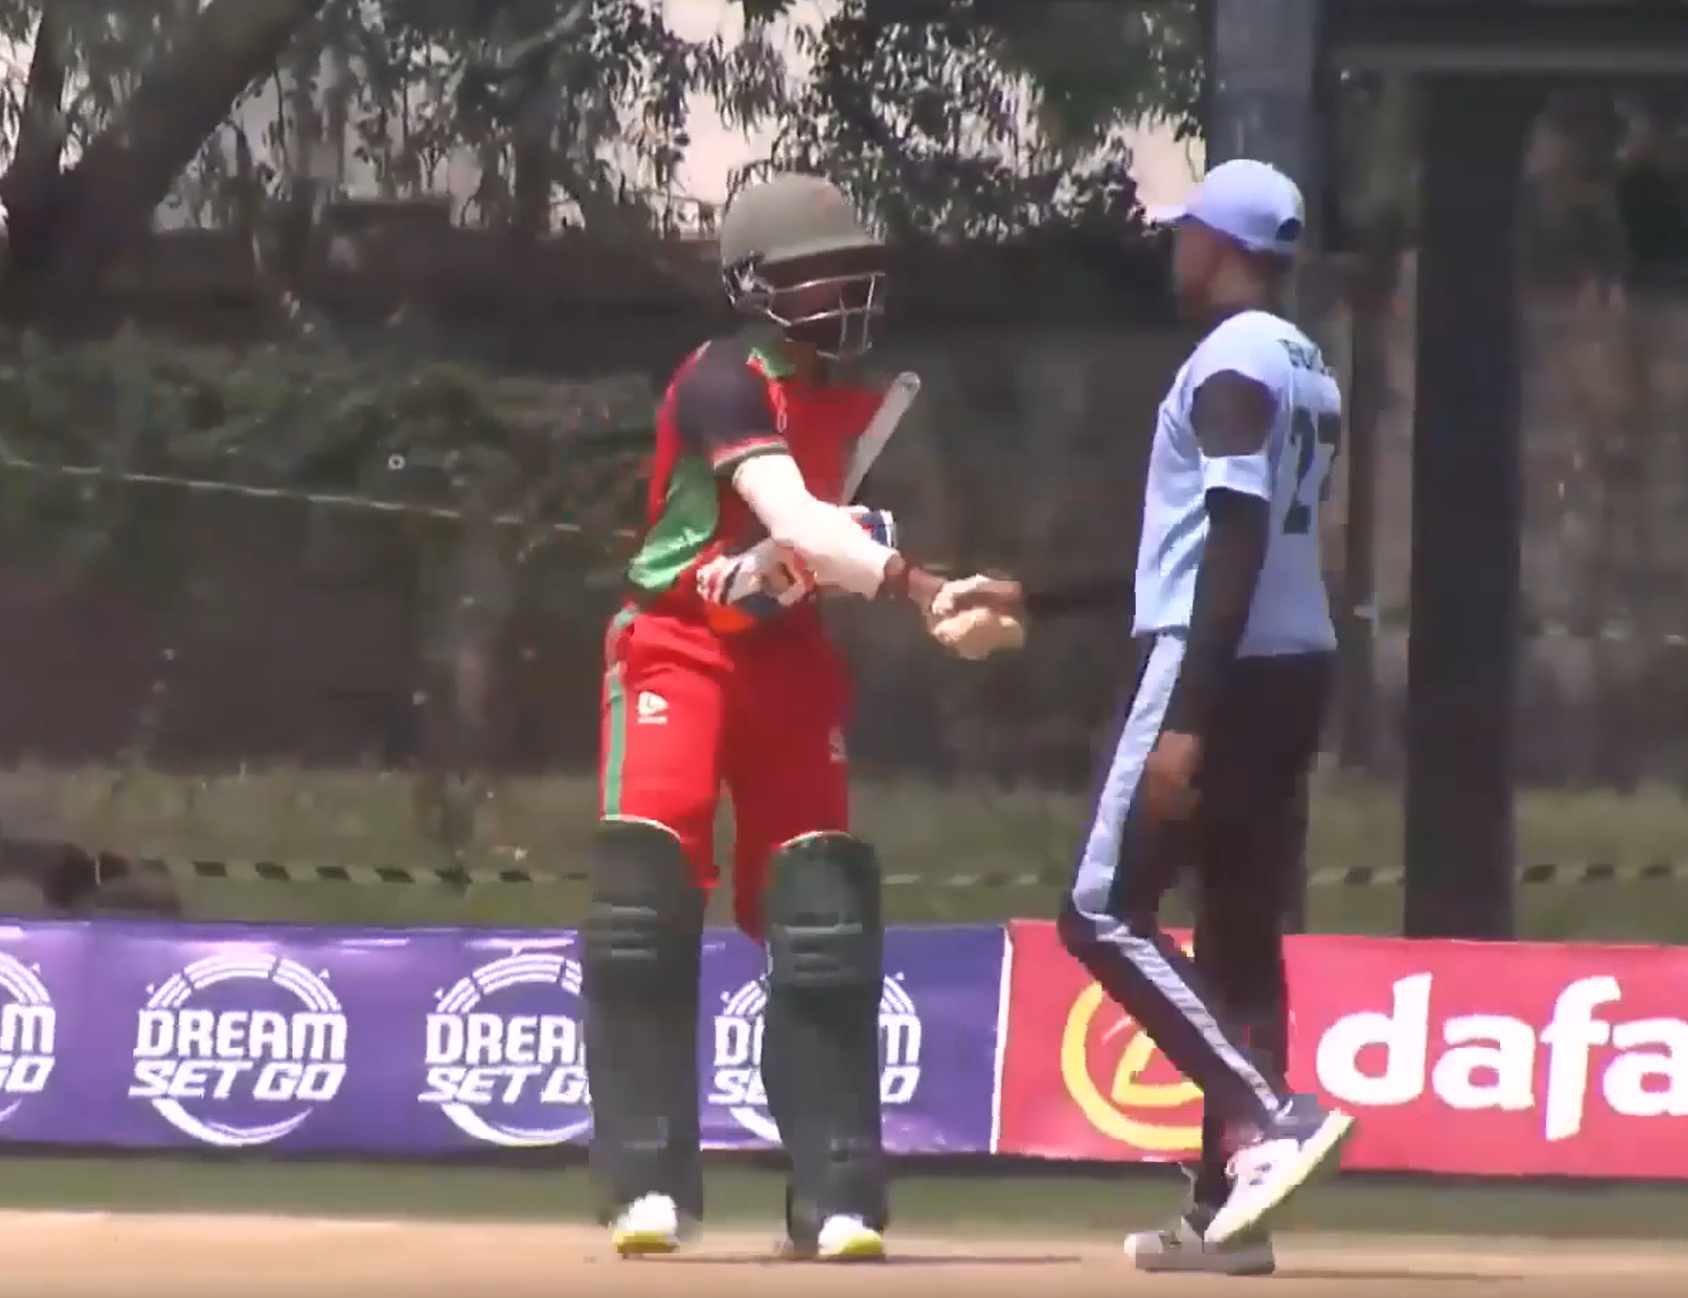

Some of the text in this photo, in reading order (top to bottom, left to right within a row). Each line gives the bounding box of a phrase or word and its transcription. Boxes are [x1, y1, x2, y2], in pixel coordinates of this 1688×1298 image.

[133, 1009, 348, 1060] DREAM
[426, 1012, 587, 1066] DREA
[1316, 972, 1688, 1141] dafa
[128, 1059, 347, 1100] SET GO
[418, 1065, 592, 1104] SET G
